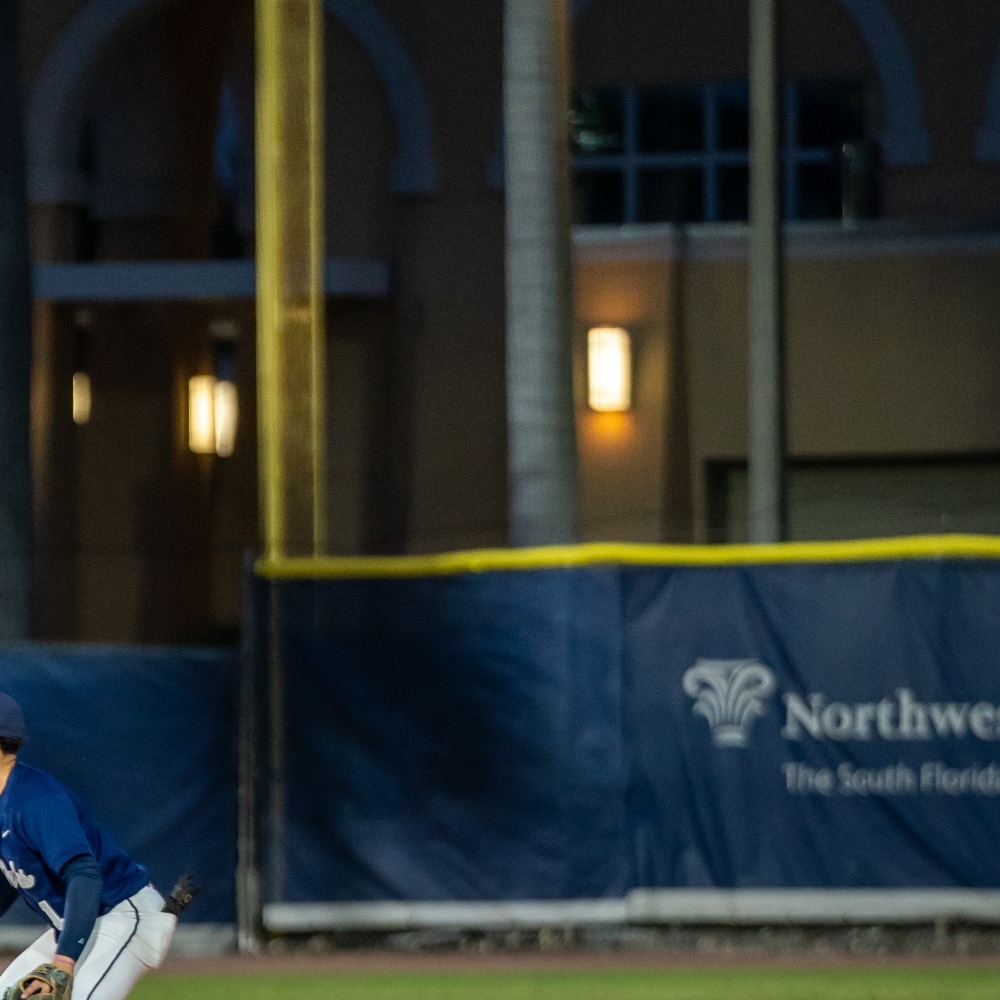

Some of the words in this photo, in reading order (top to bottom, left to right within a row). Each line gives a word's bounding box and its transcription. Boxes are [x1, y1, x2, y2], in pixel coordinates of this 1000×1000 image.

[782, 688, 1000, 741] Northwe
[784, 762, 835, 796] The
[837, 762, 917, 796] South
